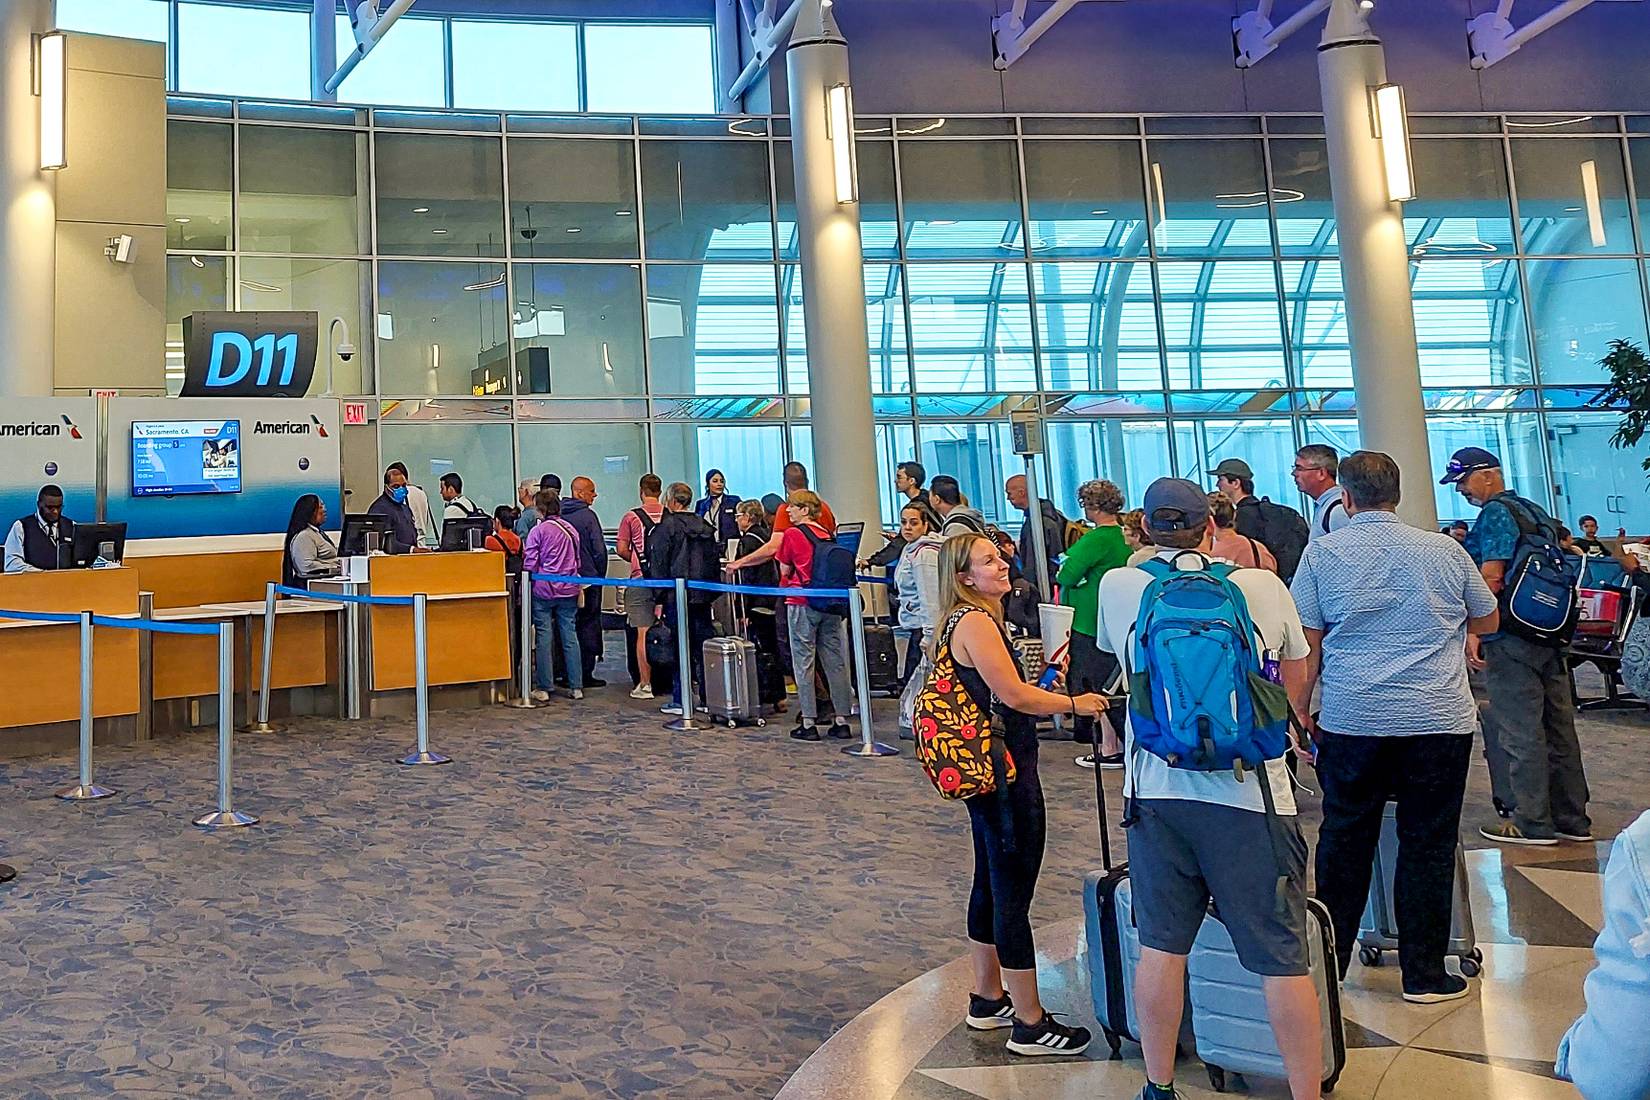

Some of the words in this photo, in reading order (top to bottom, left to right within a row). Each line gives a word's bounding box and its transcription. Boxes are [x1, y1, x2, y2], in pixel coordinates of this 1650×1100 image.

[205, 331, 298, 387] D11
[346, 404, 364, 421] EXIT
[0, 421, 60, 436] merican
[254, 420, 310, 434] American
